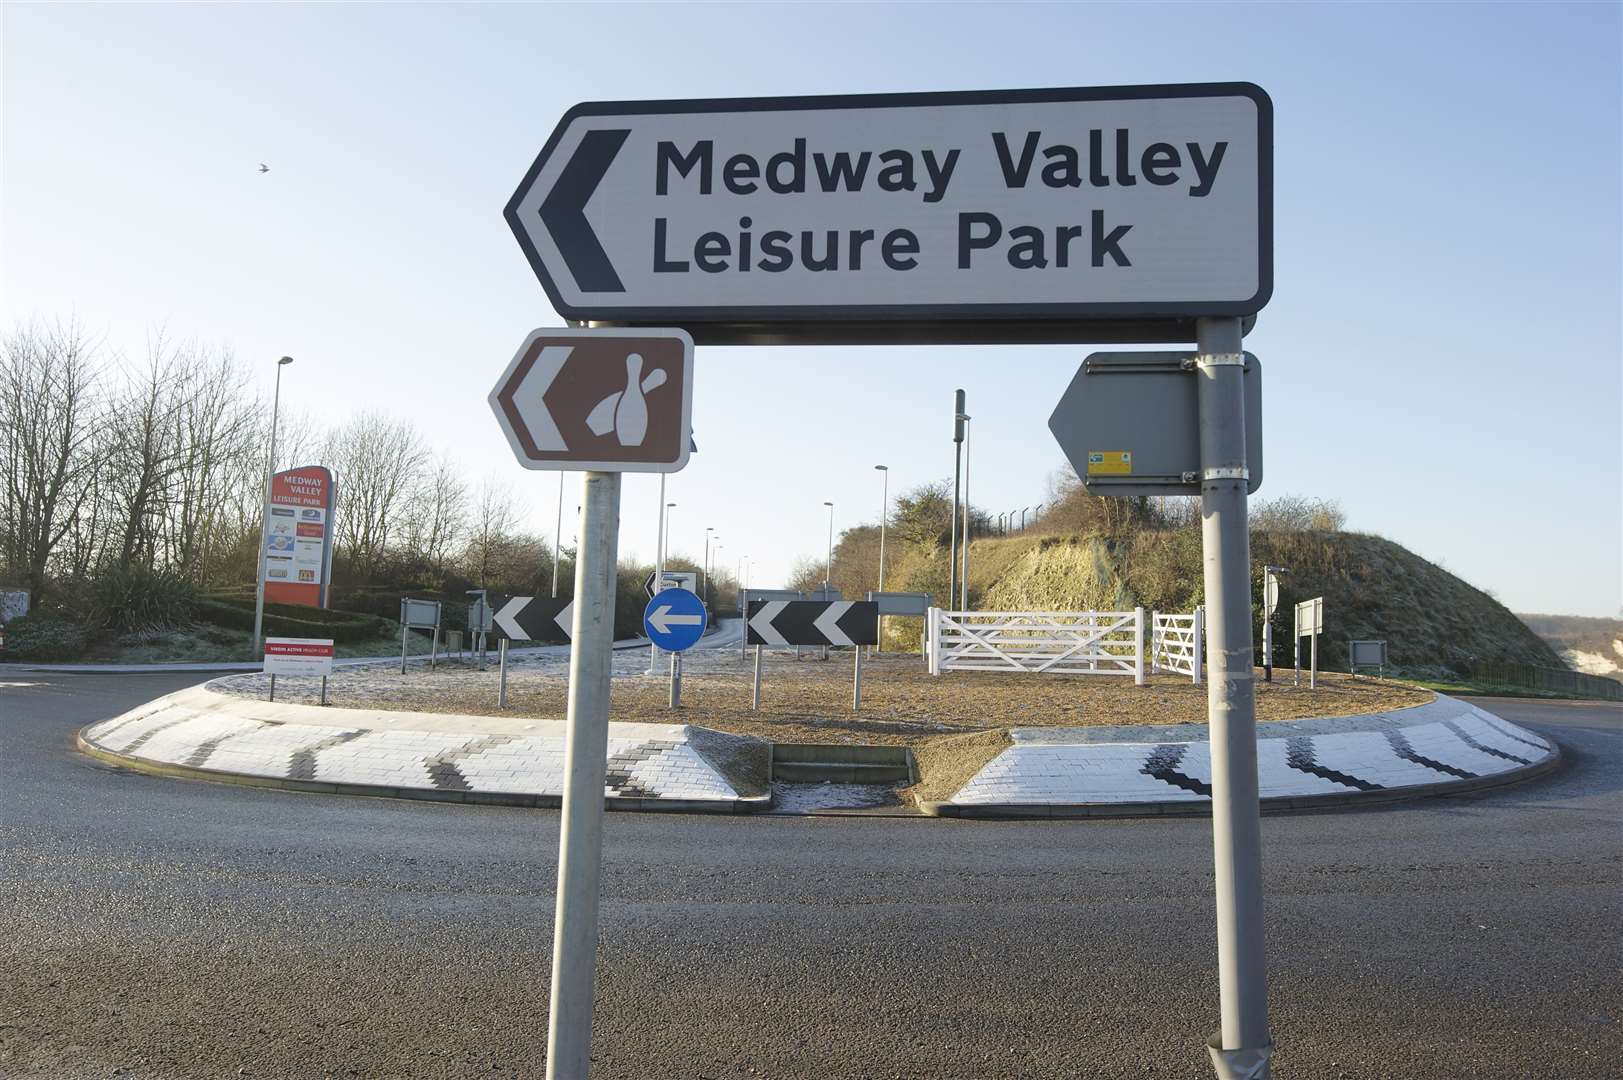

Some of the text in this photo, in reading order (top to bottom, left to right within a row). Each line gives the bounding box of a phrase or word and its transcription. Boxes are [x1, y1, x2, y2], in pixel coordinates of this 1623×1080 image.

[655, 128, 1229, 204] Medway Valley
[653, 208, 1134, 274] Leisure Park
[283, 475, 321, 487] MEDWAY
[290, 485, 321, 497] VALLEY
[273, 495, 321, 506] LEISURE PARK
